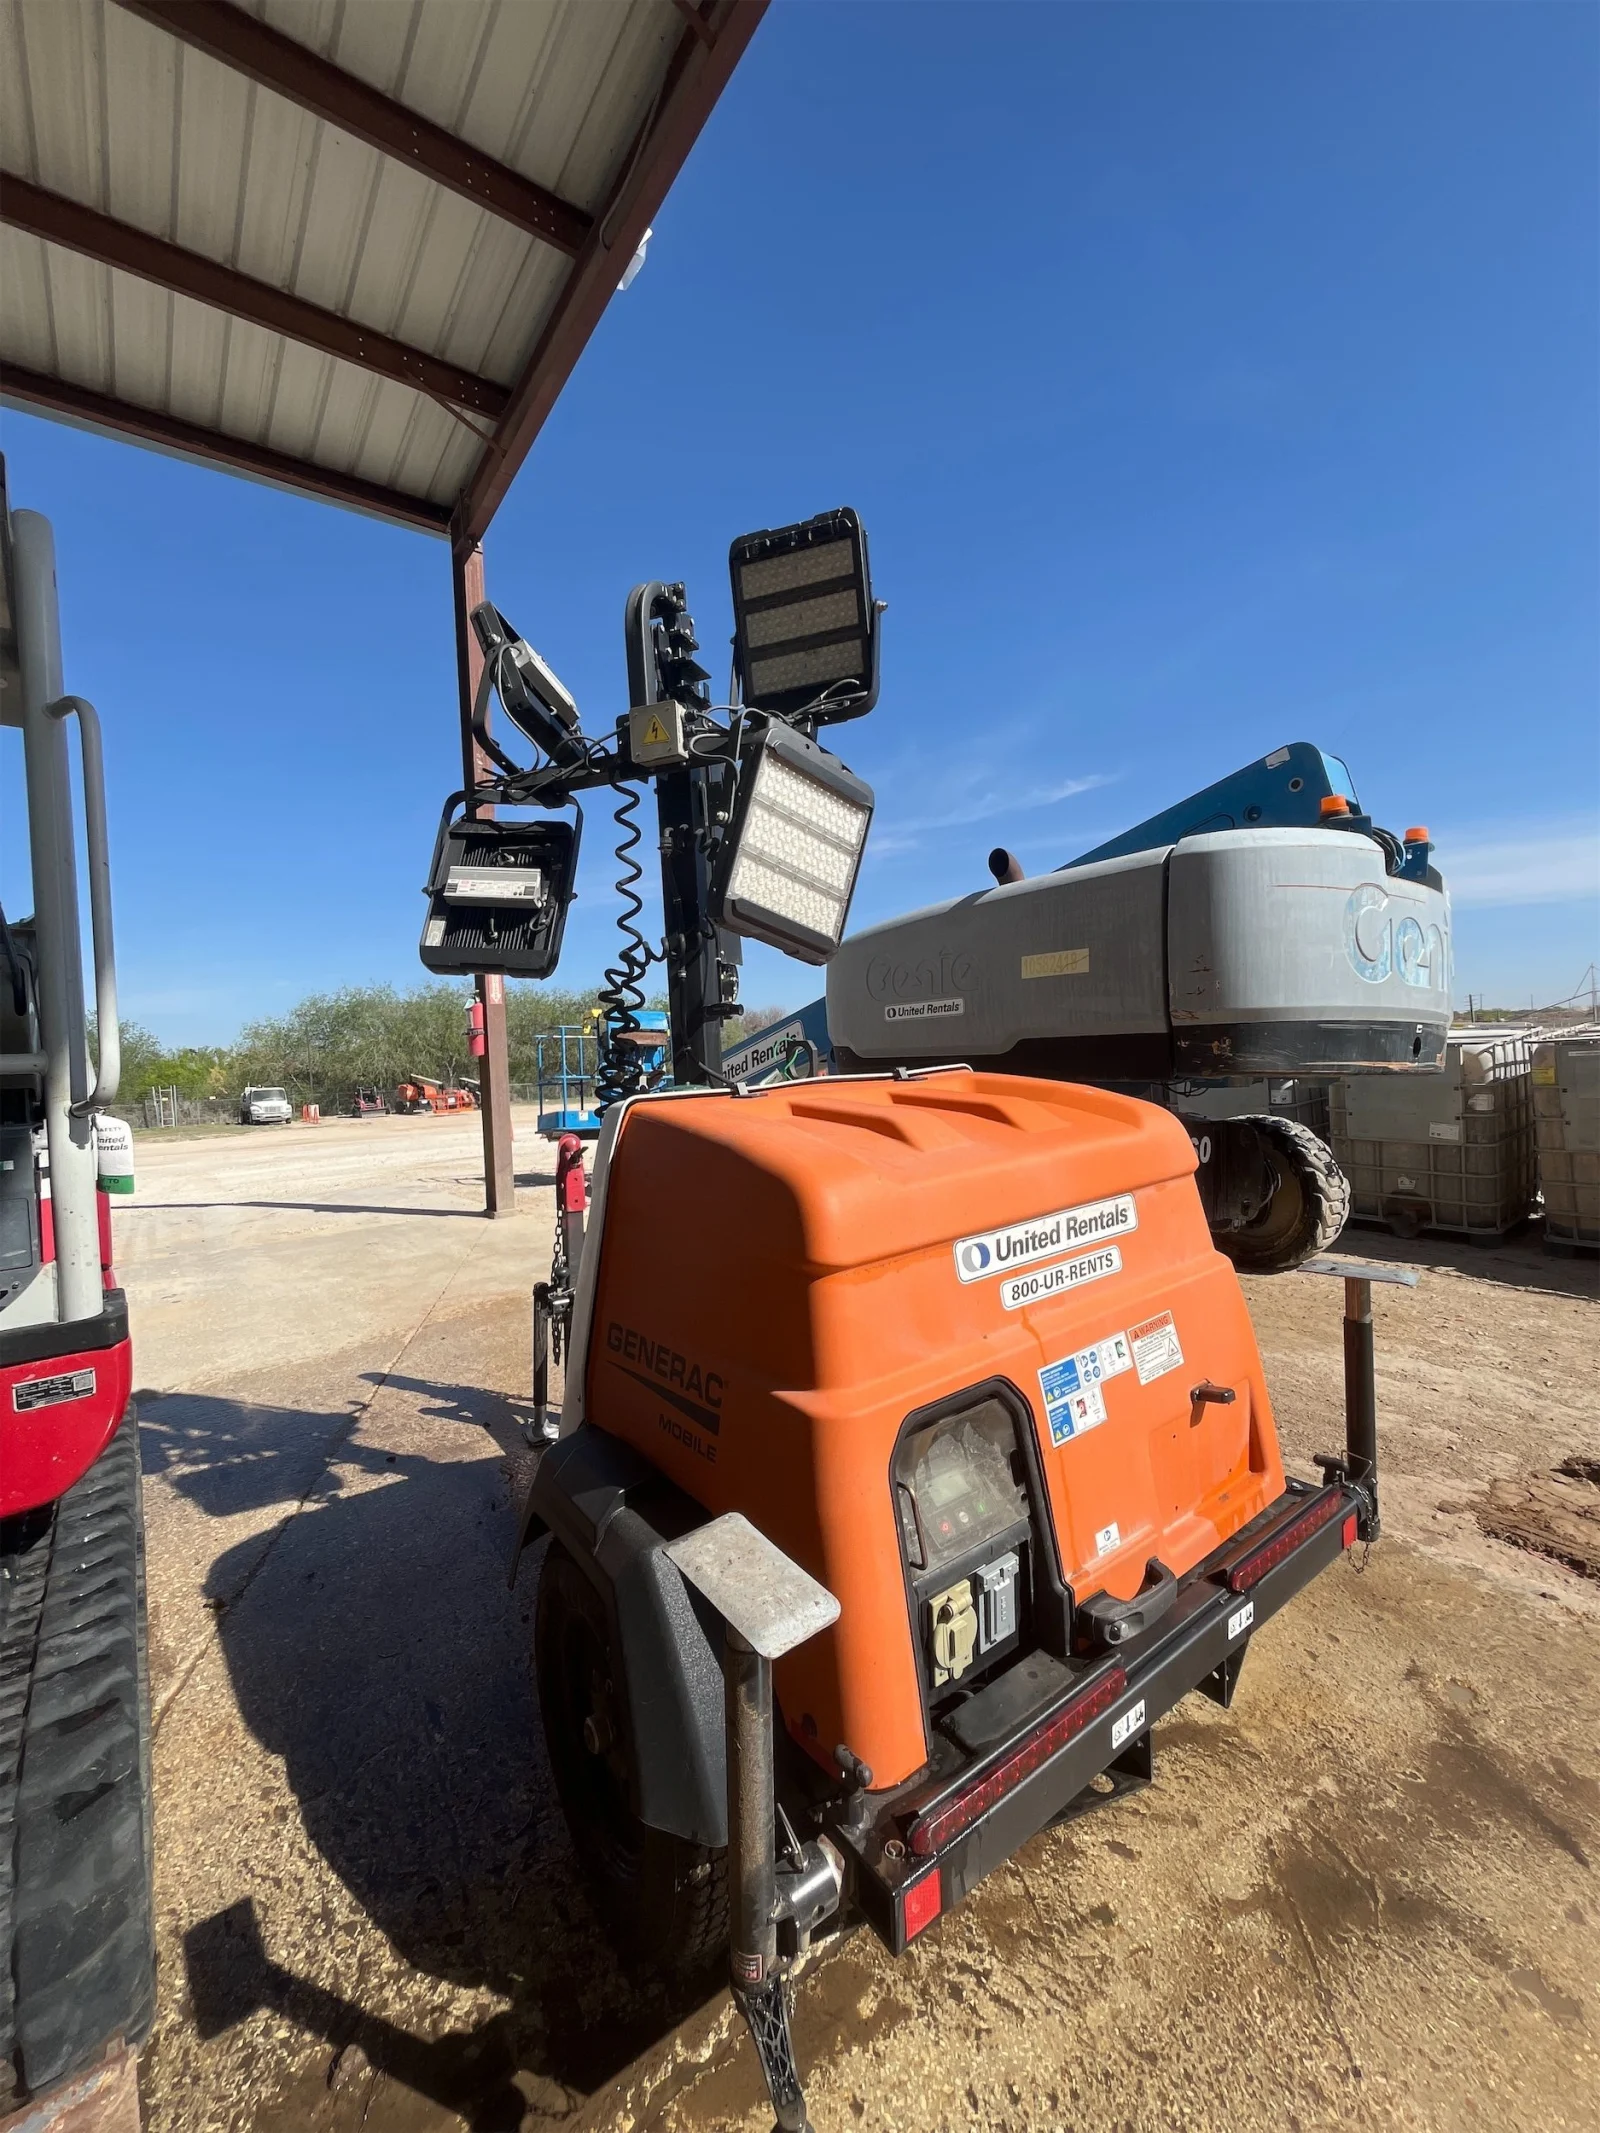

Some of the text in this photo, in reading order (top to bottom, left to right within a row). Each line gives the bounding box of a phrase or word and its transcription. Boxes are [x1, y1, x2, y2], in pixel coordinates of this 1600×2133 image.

[1342, 882, 1454, 993] Geni
[898, 1001, 960, 1017] United Rentals
[722, 1054, 748, 1080] nited
[97, 1135, 126, 1143] nited
[97, 1143, 129, 1151] entals
[996, 1204, 1128, 1262] United Rentals
[1011, 1252, 1113, 1301] 800-UR-RENTS
[607, 1322, 724, 1409] GENERAC
[658, 1413, 718, 1464] MOBILE
